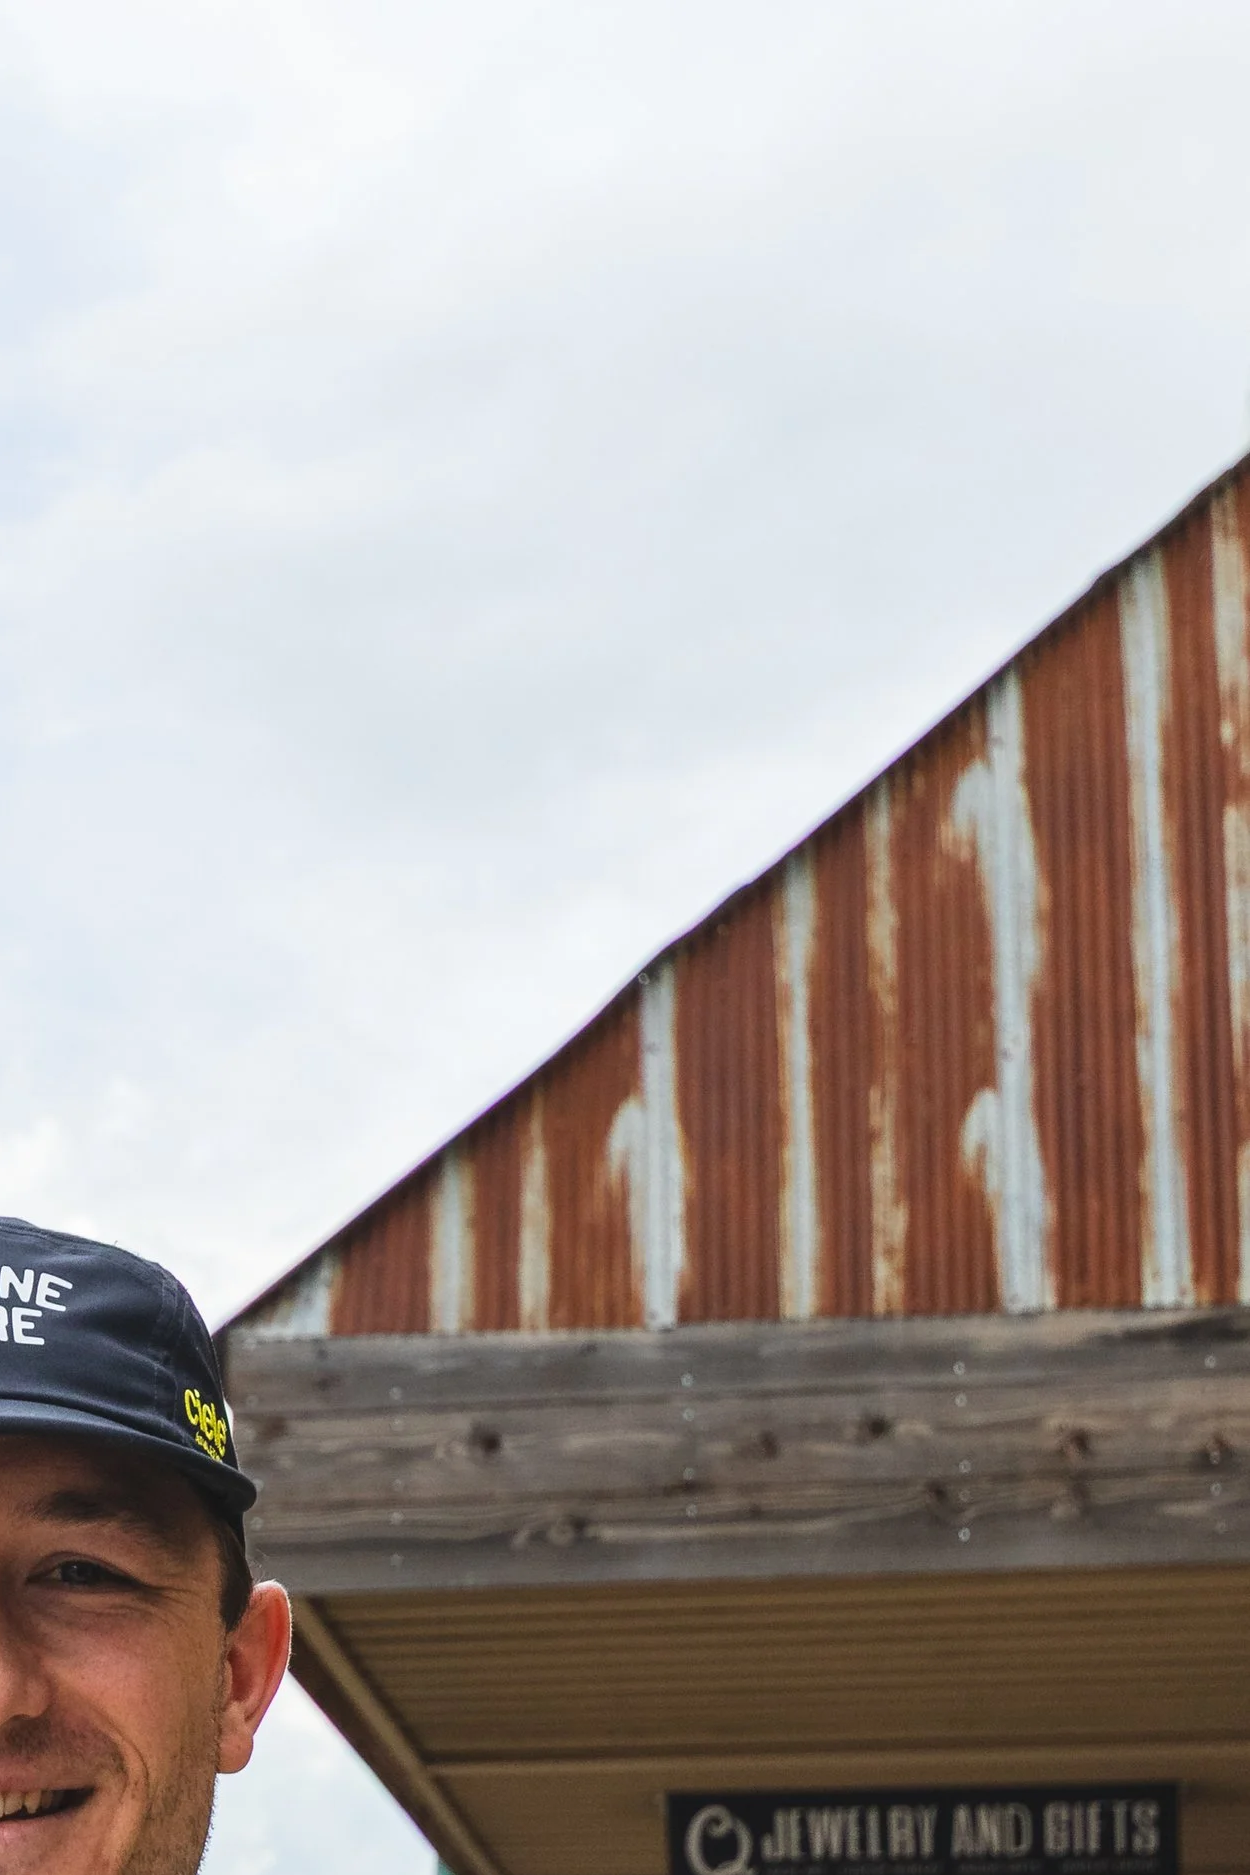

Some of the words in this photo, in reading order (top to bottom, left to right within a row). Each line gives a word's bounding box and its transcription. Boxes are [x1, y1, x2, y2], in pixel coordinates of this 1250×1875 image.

[760, 1804, 938, 1861] JEWELRY
[950, 1802, 1034, 1860] AND
[1043, 1799, 1160, 1858] GIFTS
